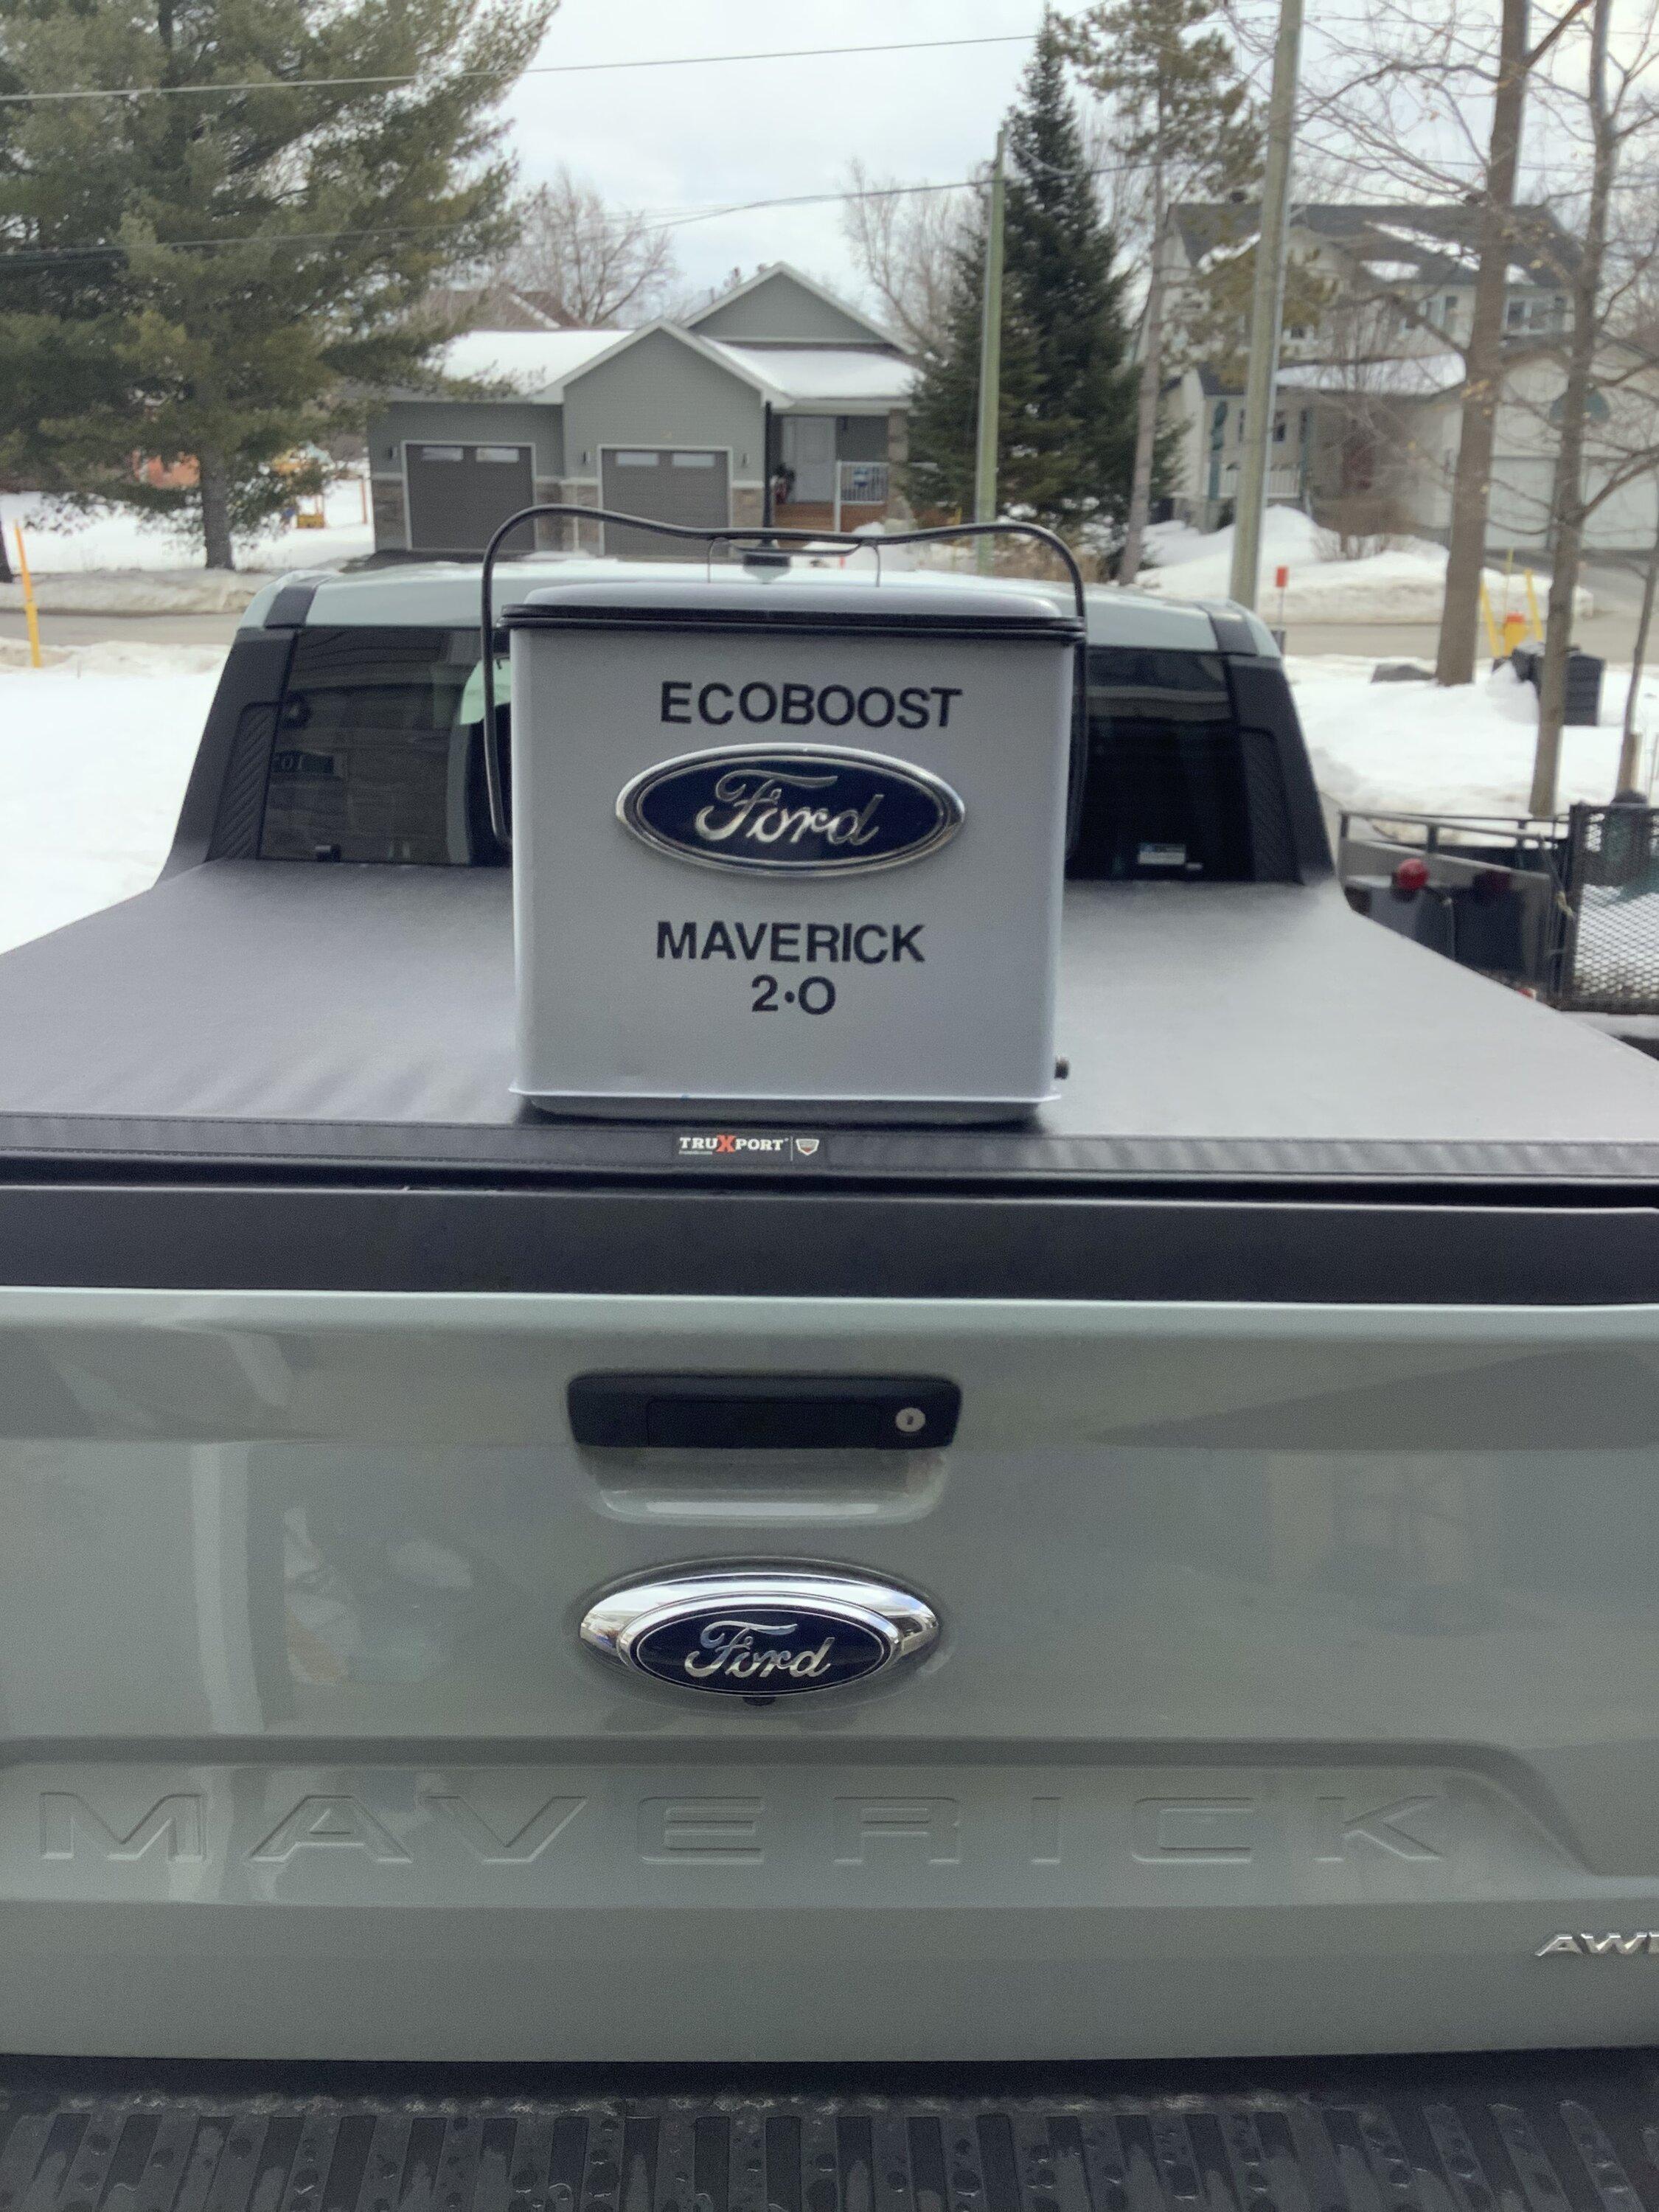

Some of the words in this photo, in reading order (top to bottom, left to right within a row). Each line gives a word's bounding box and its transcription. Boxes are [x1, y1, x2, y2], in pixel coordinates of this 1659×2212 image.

[661, 681, 963, 728] ECOBOOST
[695, 768, 885, 846] Ford
[655, 920, 926, 964] MAVERICK
[684, 1620, 832, 1678] Ford
[39, 1791, 1444, 1865] MAVERICK
